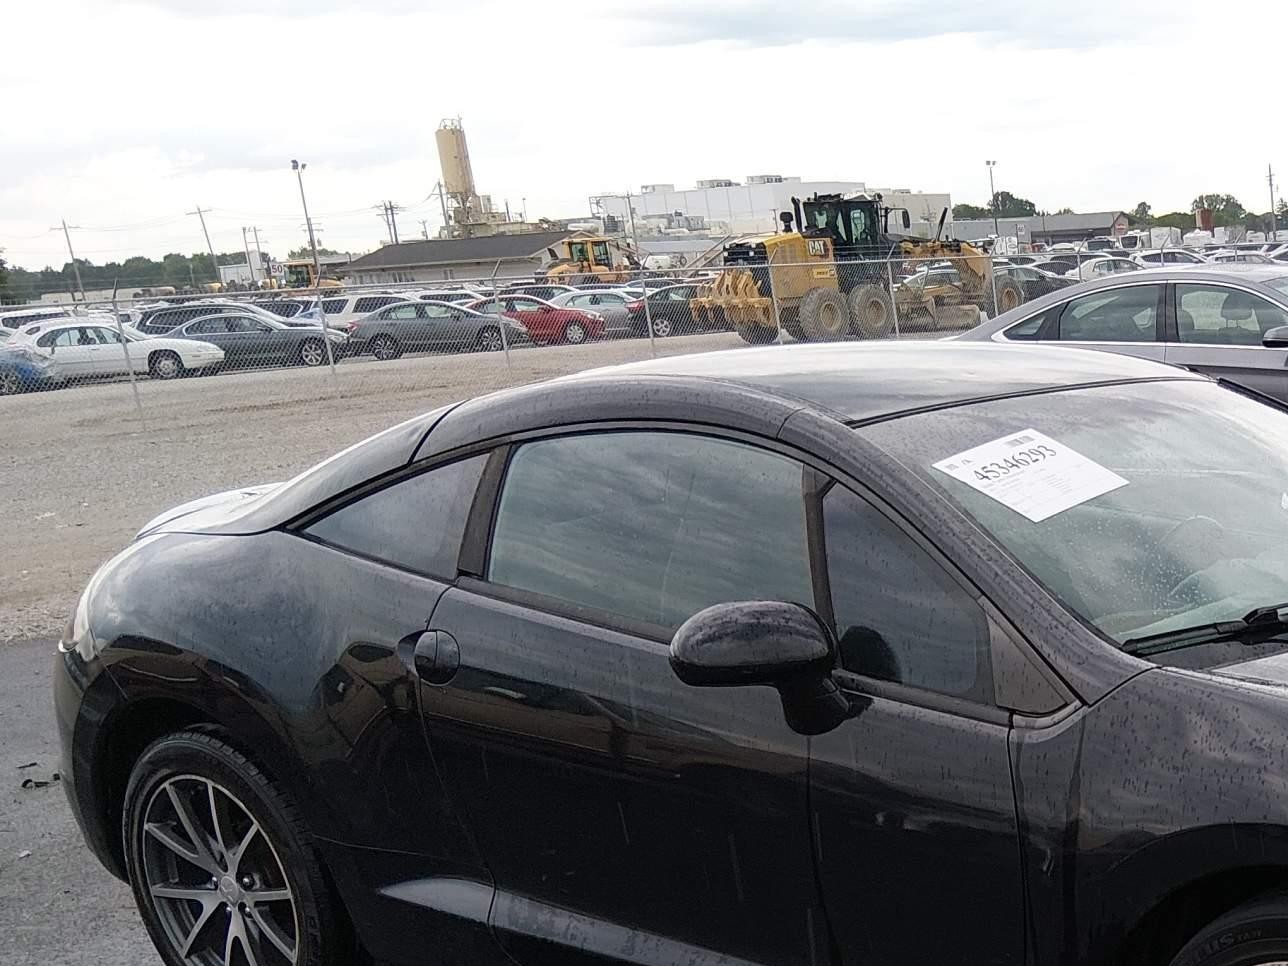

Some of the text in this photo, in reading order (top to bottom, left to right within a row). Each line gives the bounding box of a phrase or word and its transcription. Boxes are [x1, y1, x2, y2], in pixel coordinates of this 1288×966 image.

[808, 240, 825, 256] CAT
[271, 264, 283, 273] 50
[973, 444, 1058, 482] 45346293
